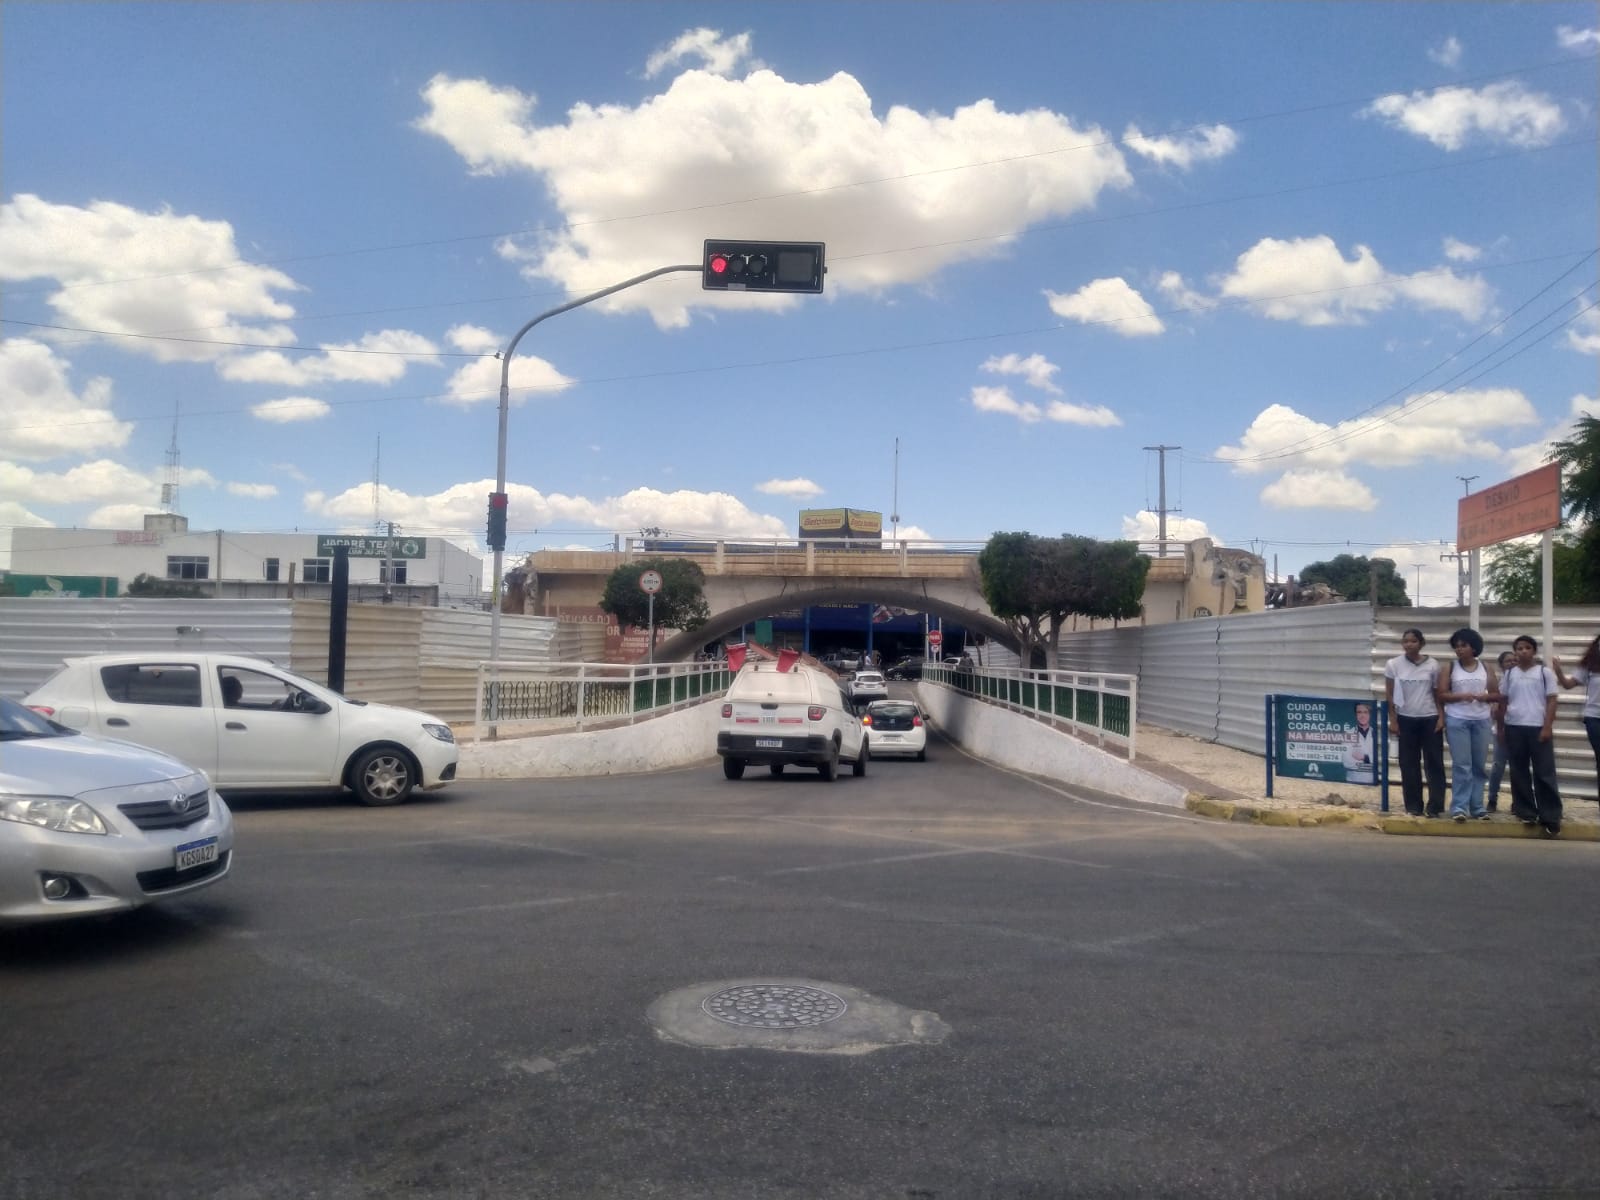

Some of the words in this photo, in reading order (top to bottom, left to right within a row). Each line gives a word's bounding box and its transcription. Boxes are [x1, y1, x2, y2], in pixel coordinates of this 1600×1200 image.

[1485, 484, 1520, 511] DESVIO
[1286, 703, 1326, 712] CUIDAR
[1287, 713, 1302, 721] DO
[1305, 713, 1326, 721] SEU
[1287, 722, 1341, 732] CORAÇÃO
[1343, 722, 1351, 732] É
[1288, 732, 1303, 741] NA
[1306, 732, 1358, 742] MEDIVALE
